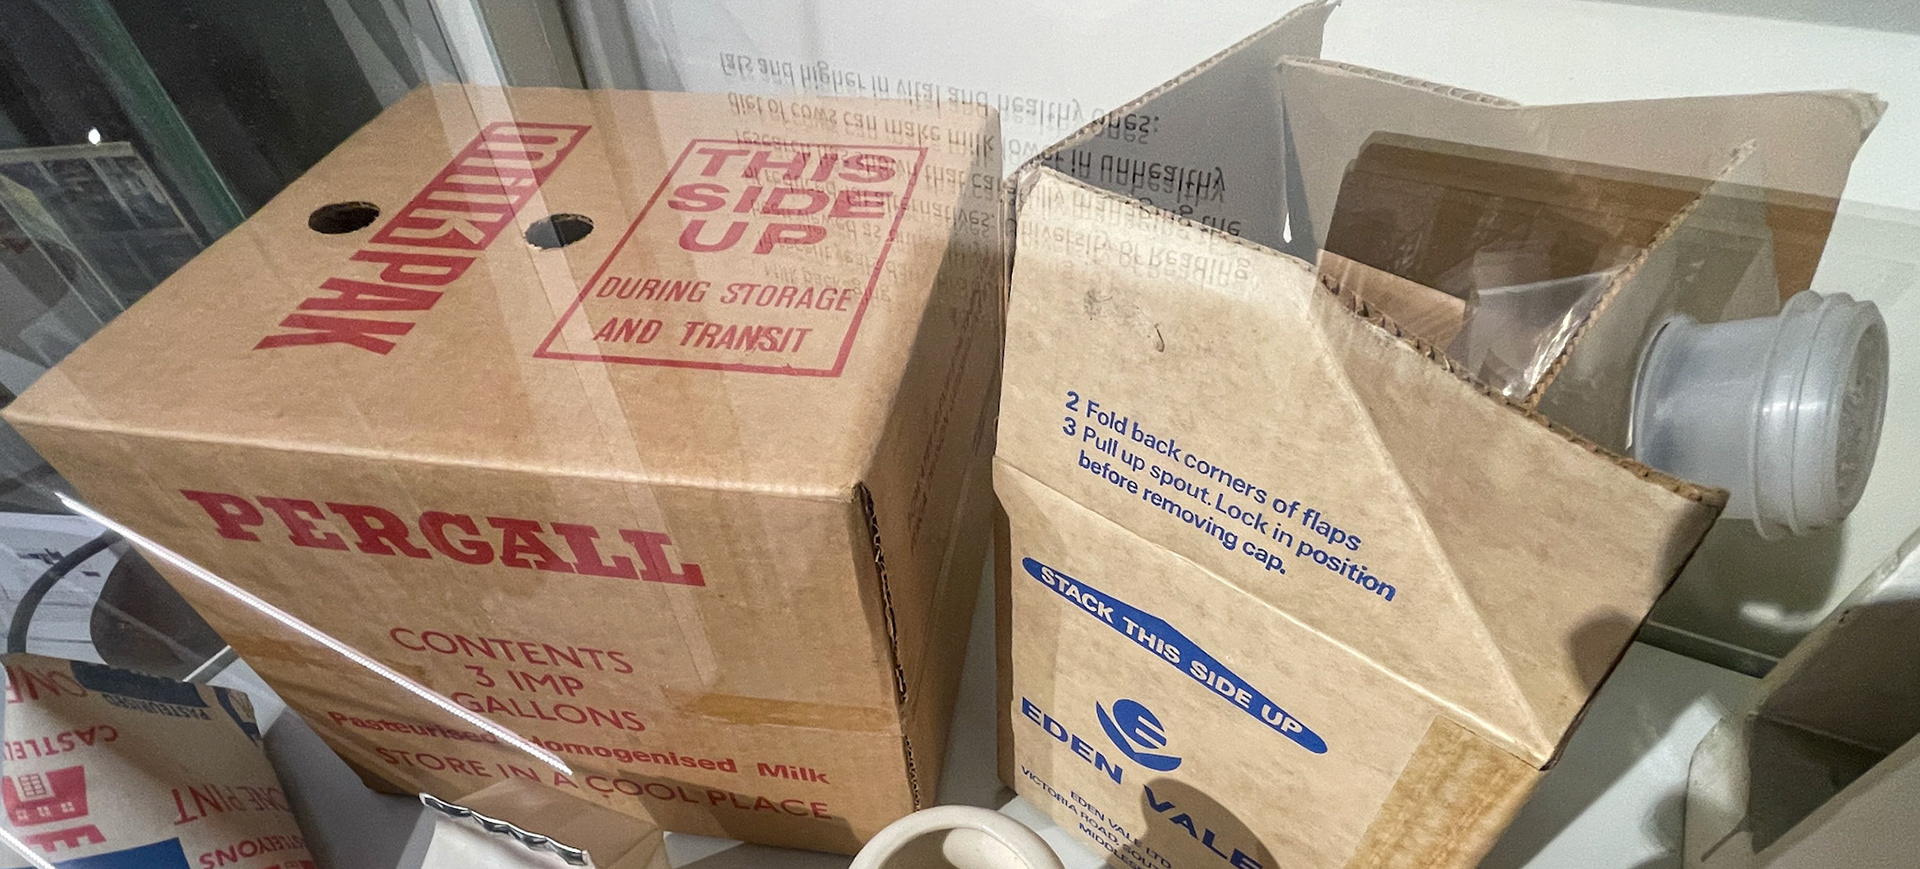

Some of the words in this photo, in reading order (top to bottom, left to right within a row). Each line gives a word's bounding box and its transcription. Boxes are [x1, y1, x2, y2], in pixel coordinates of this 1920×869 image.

[696, 147, 896, 184] THIS
[667, 182, 894, 219] SIDE
[677, 219, 828, 255] UP
[596, 276, 711, 303] DURING
[719, 282, 855, 312] STORAGE
[593, 316, 663, 344] AND
[680, 321, 814, 353] TRANSIT
[1065, 390, 1080, 412] 2
[1086, 399, 1129, 436] Fold
[1131, 420, 1182, 463] back
[1184, 452, 1268, 505] corners
[1272, 500, 1301, 519] of
[1302, 507, 1362, 552] flaps
[1062, 416, 1077, 437] 3
[1082, 425, 1119, 458] Pull
[1121, 448, 1146, 473] up
[1149, 463, 1212, 506] spout.
[1214, 493, 1269, 536] Lock
[1272, 522, 1294, 549] in
[1295, 538, 1397, 603] position
[1078, 449, 1139, 494] before
[1142, 487, 1239, 552] removing
[1242, 539, 1286, 576] cap.
[180, 489, 706, 587] PERGALL
[390, 627, 634, 674] CONTENTS
[1039, 565, 1115, 625] STACK
[1122, 615, 1181, 665] THIS
[1189, 659, 1253, 710] SIDE
[1260, 704, 1304, 736] UP
[465, 664, 496, 688] 3
[507, 669, 584, 697] IMP
[450, 691, 645, 732] GALLONS
[375, 746, 493, 778] STORE
[496, 763, 542, 784] IN
[553, 771, 579, 789] A
[585, 775, 699, 804] COOL
[707, 789, 832, 820] PLACE
[757, 761, 830, 785] Milk
[1021, 696, 1123, 785] EDEN
[1142, 783, 1264, 869] VALE
[173, 783, 244, 827] PINT
[1021, 765, 1078, 816] VICTORIA
[1080, 813, 1120, 847] ROAD,
[1070, 790, 1105, 822] EDEN
[1108, 818, 1143, 849] VALE
[1146, 847, 1172, 869] LTD
